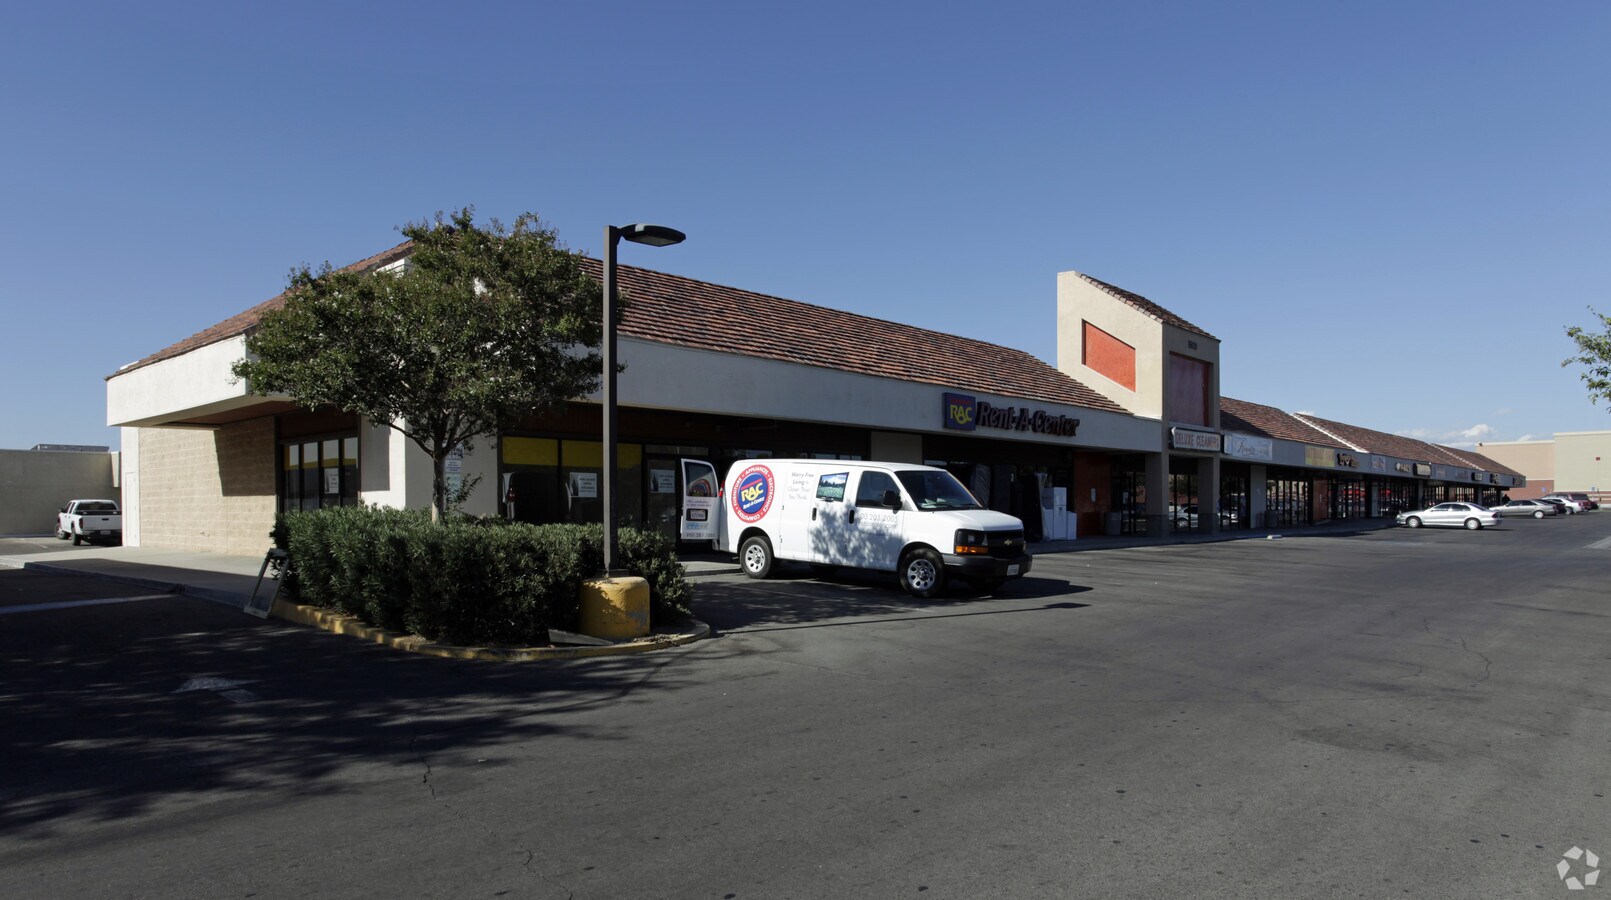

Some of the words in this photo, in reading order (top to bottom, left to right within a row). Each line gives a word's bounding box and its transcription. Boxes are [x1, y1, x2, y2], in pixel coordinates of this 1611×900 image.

[949, 404, 972, 425] RAC
[976, 402, 1080, 437] Rent-A-Center
[1175, 431, 1194, 446] DELUXE
[745, 466, 769, 475] APPLIANCES
[732, 477, 742, 506] FURNITURE
[741, 482, 764, 502] RAC
[762, 477, 774, 512] ELECTRONICS
